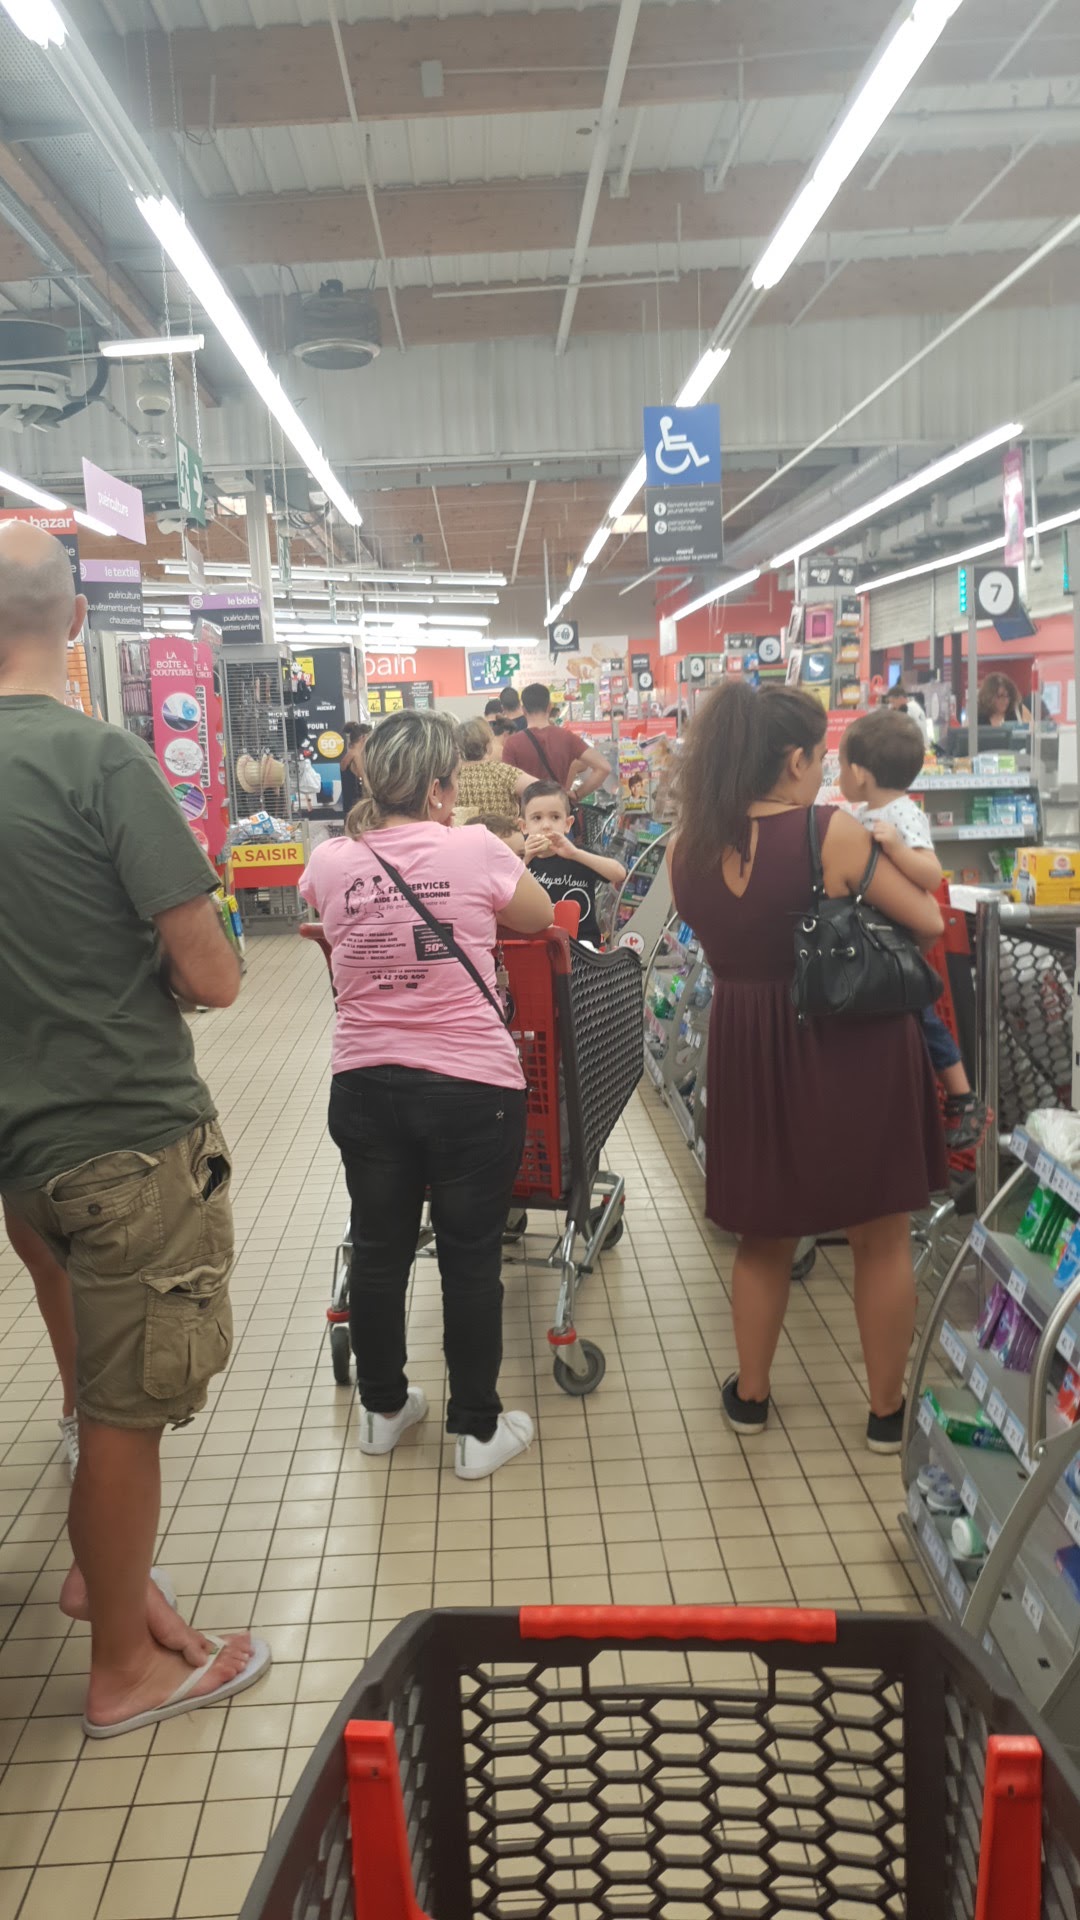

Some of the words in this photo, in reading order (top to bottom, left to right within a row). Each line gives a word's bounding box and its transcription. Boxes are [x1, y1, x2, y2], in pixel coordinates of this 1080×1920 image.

[30, 515, 72, 528] bazar
[104, 566, 112, 577] le
[112, 566, 140, 578] textile
[990, 584, 1003, 602] 7
[227, 596, 236, 605] le
[236, 595, 259, 605] bébé
[223, 613, 260, 622] puériculture
[240, 623, 260, 631] enfant
[166, 651, 177, 660] LA
[152, 668, 194, 677] COUTURE
[231, 850, 241, 862] A
[244, 847, 297, 862] SAISIR
[388, 886, 400, 894] FE
[374, 896, 391, 904] AIDE
[417, 891, 451, 899] ERSONNE
[425, 943, 448, 953] 50%
